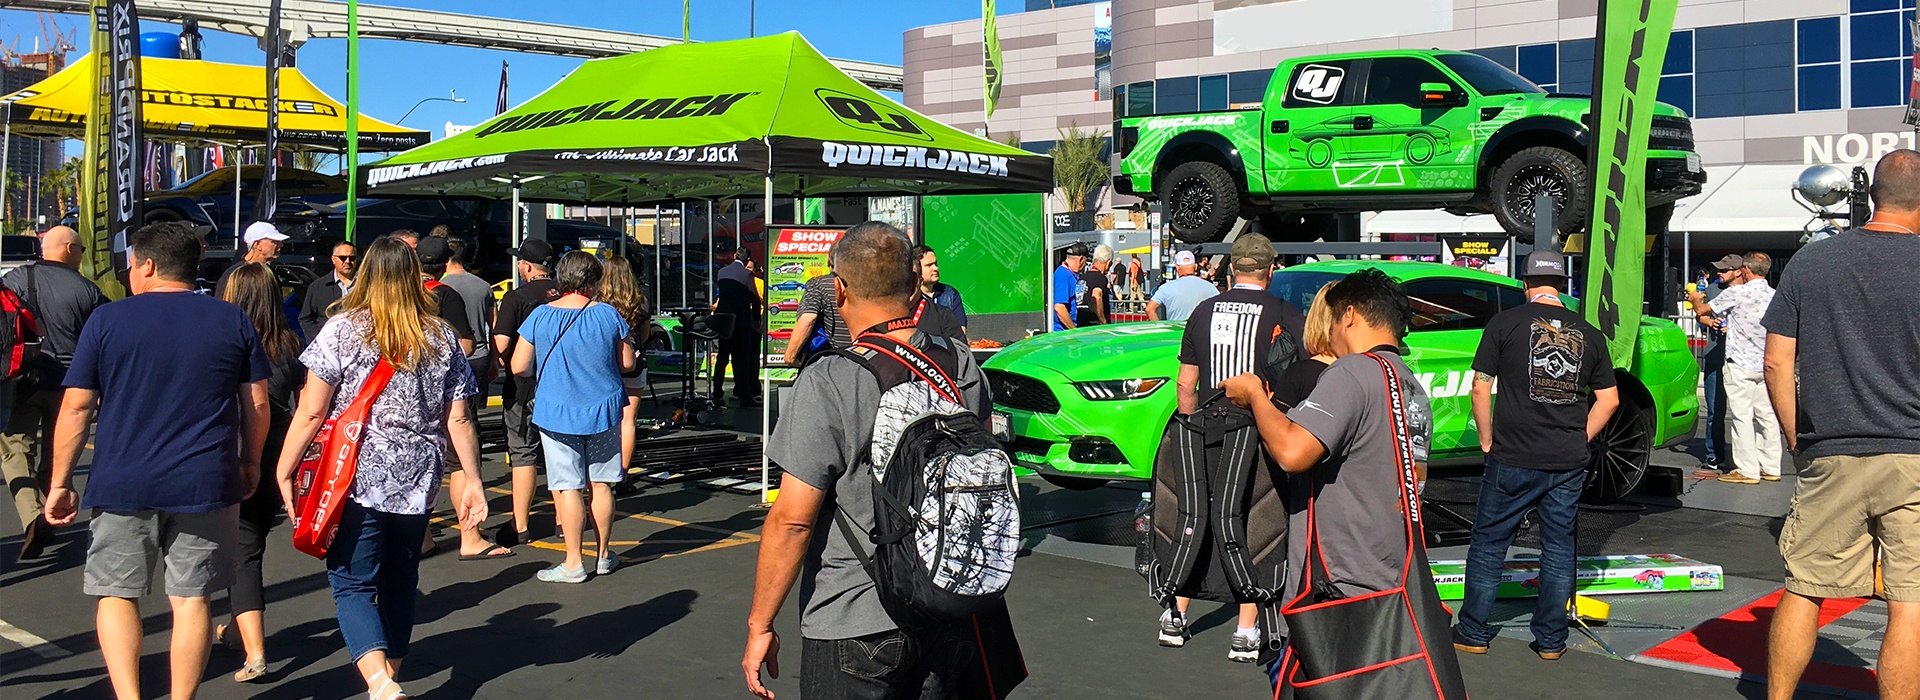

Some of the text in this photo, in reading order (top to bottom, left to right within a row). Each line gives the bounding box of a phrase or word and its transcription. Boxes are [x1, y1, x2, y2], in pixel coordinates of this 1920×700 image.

[142, 90, 336, 115] TOSTACKER
[475, 91, 752, 138] QUICKJACK
[824, 96, 925, 135] QJ
[1147, 114, 1238, 130] QUICKJACK
[664, 146, 696, 162] Car
[697, 143, 739, 163] Jack
[822, 141, 1009, 176] QUICKJACK
[367, 154, 510, 188] QUICKJACK.com
[791, 231, 838, 241] SHOW
[777, 242, 831, 252] SPECIA
[1213, 301, 1263, 315] FREEDOM
[1433, 576, 1464, 584] KJACK
